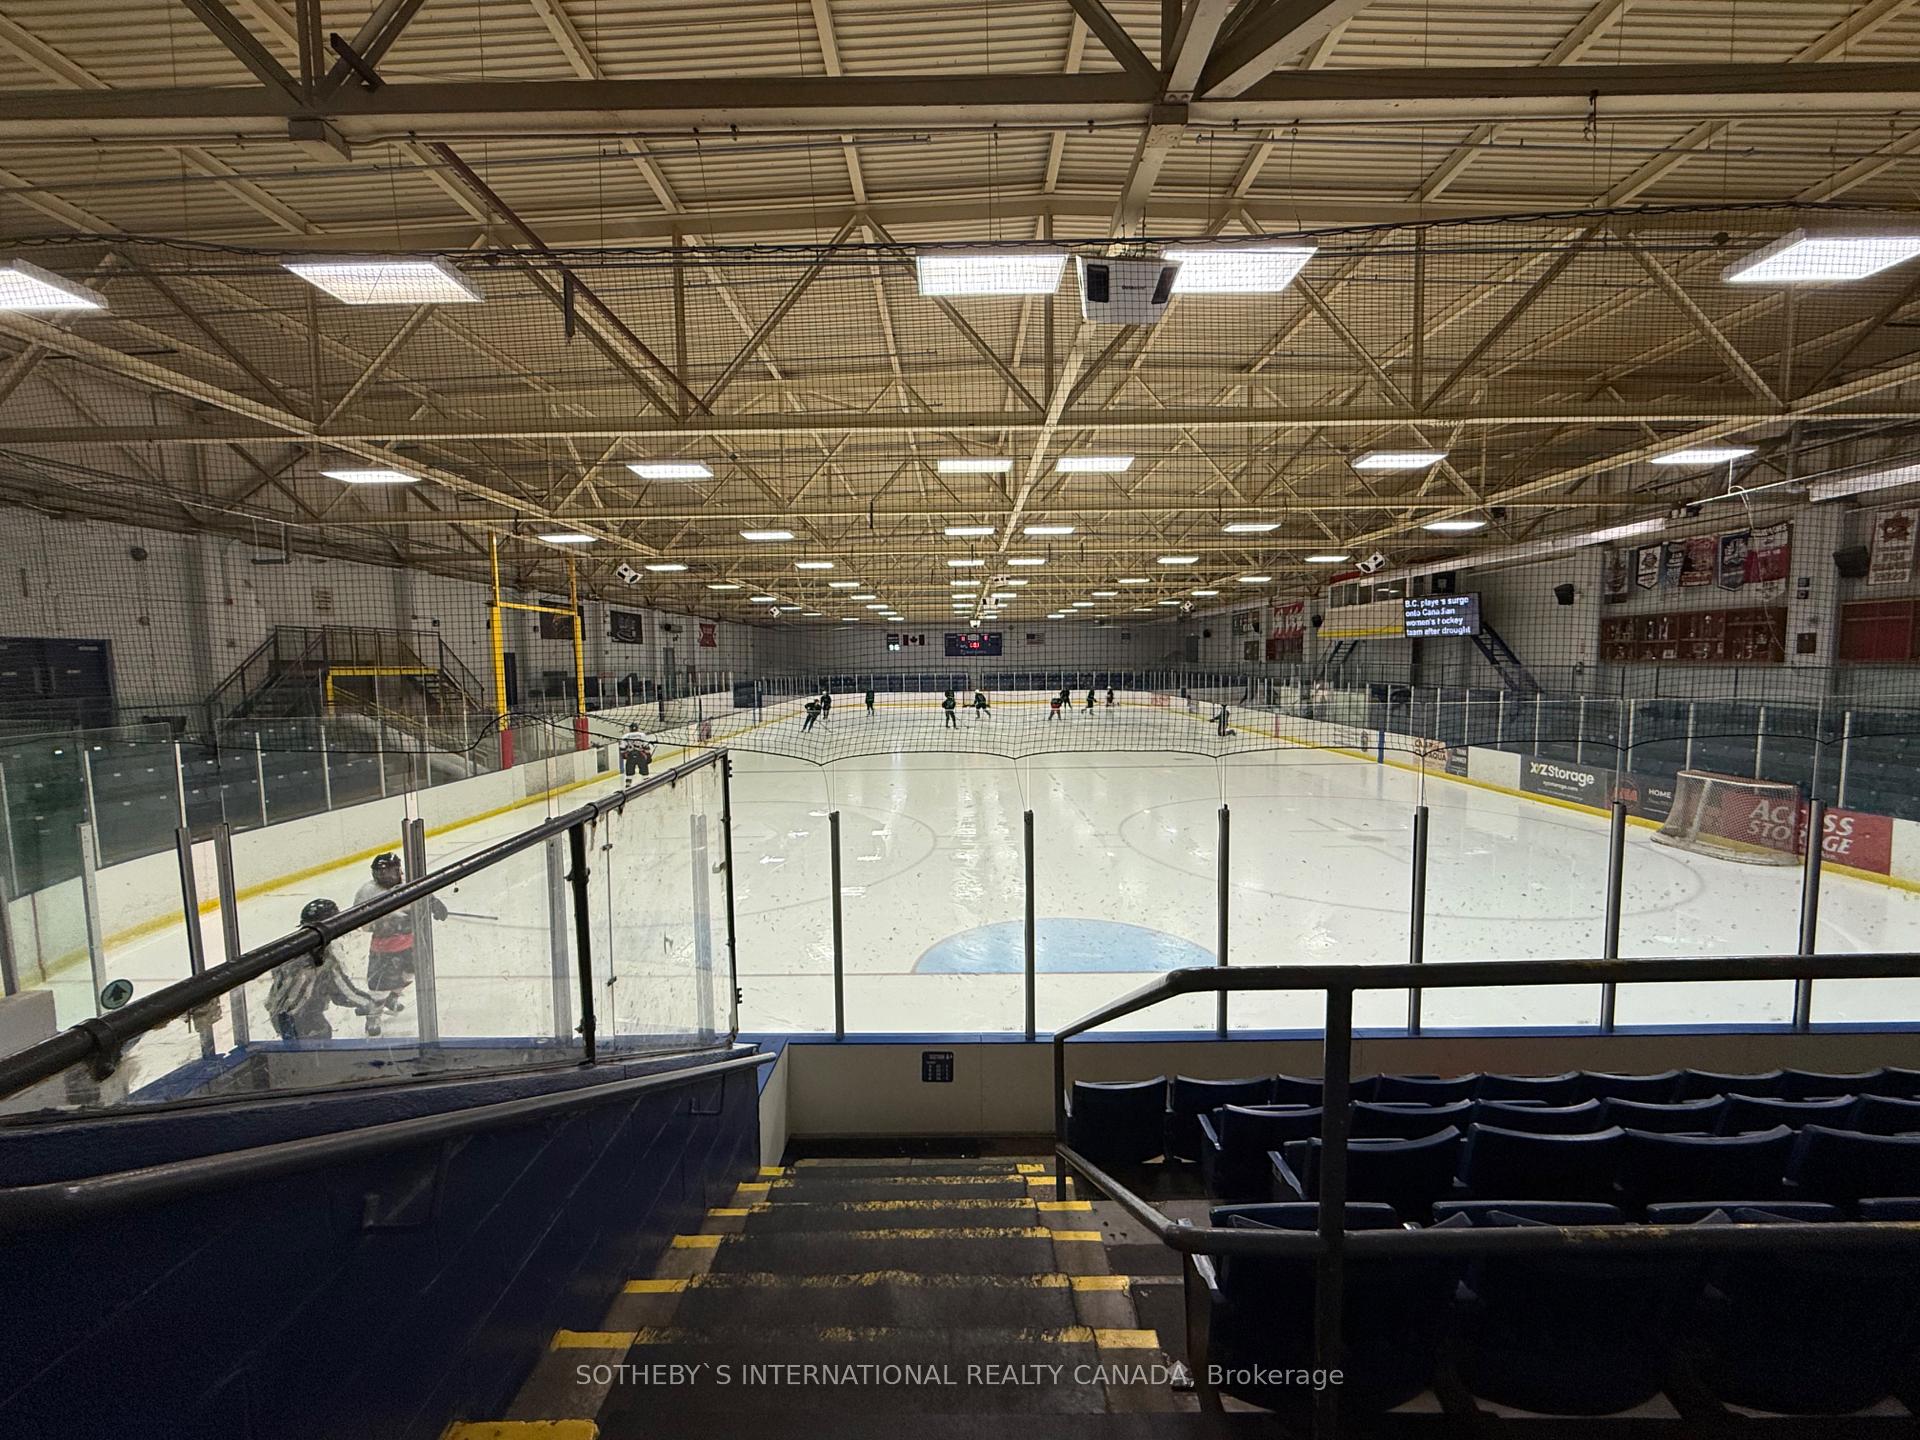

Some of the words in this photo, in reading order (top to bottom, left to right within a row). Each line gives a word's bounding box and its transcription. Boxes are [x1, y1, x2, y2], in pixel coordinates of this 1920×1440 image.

[1405, 600, 1419, 608] B.C.
[1447, 597, 1469, 605] surge
[1406, 618, 1436, 626] women's
[1441, 626, 1471, 635] drought
[1648, 787, 1673, 799] HOME
[1750, 800, 1855, 836] ACSS
[1747, 820, 1854, 854] STOGE
